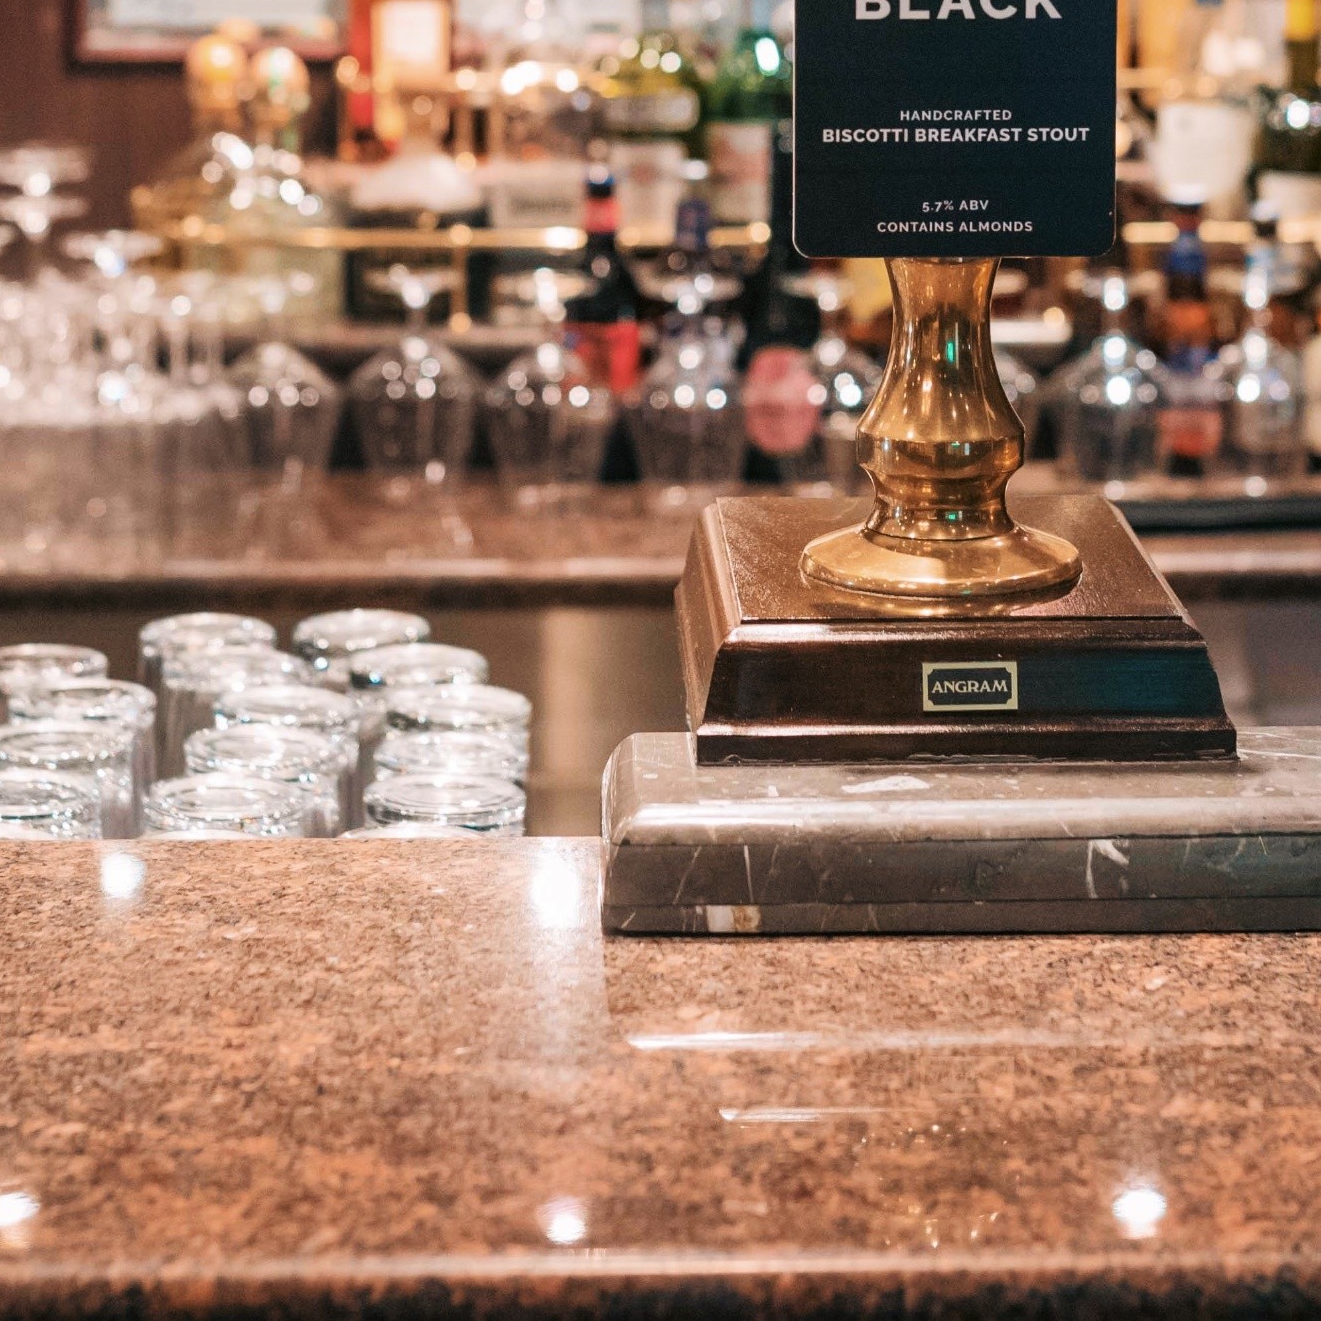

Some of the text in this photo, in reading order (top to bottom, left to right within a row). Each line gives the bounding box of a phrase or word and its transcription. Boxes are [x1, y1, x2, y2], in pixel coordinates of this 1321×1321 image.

[900, 109, 1012, 121] HANDCRAFTED
[822, 127, 1090, 143] BISCOTTI BREAKFAST STOUT
[921, 199, 989, 213] 5.7% ABV
[877, 221, 1033, 233] CONTAINS ALMONDS
[931, 679, 1009, 694] ANGRAM
